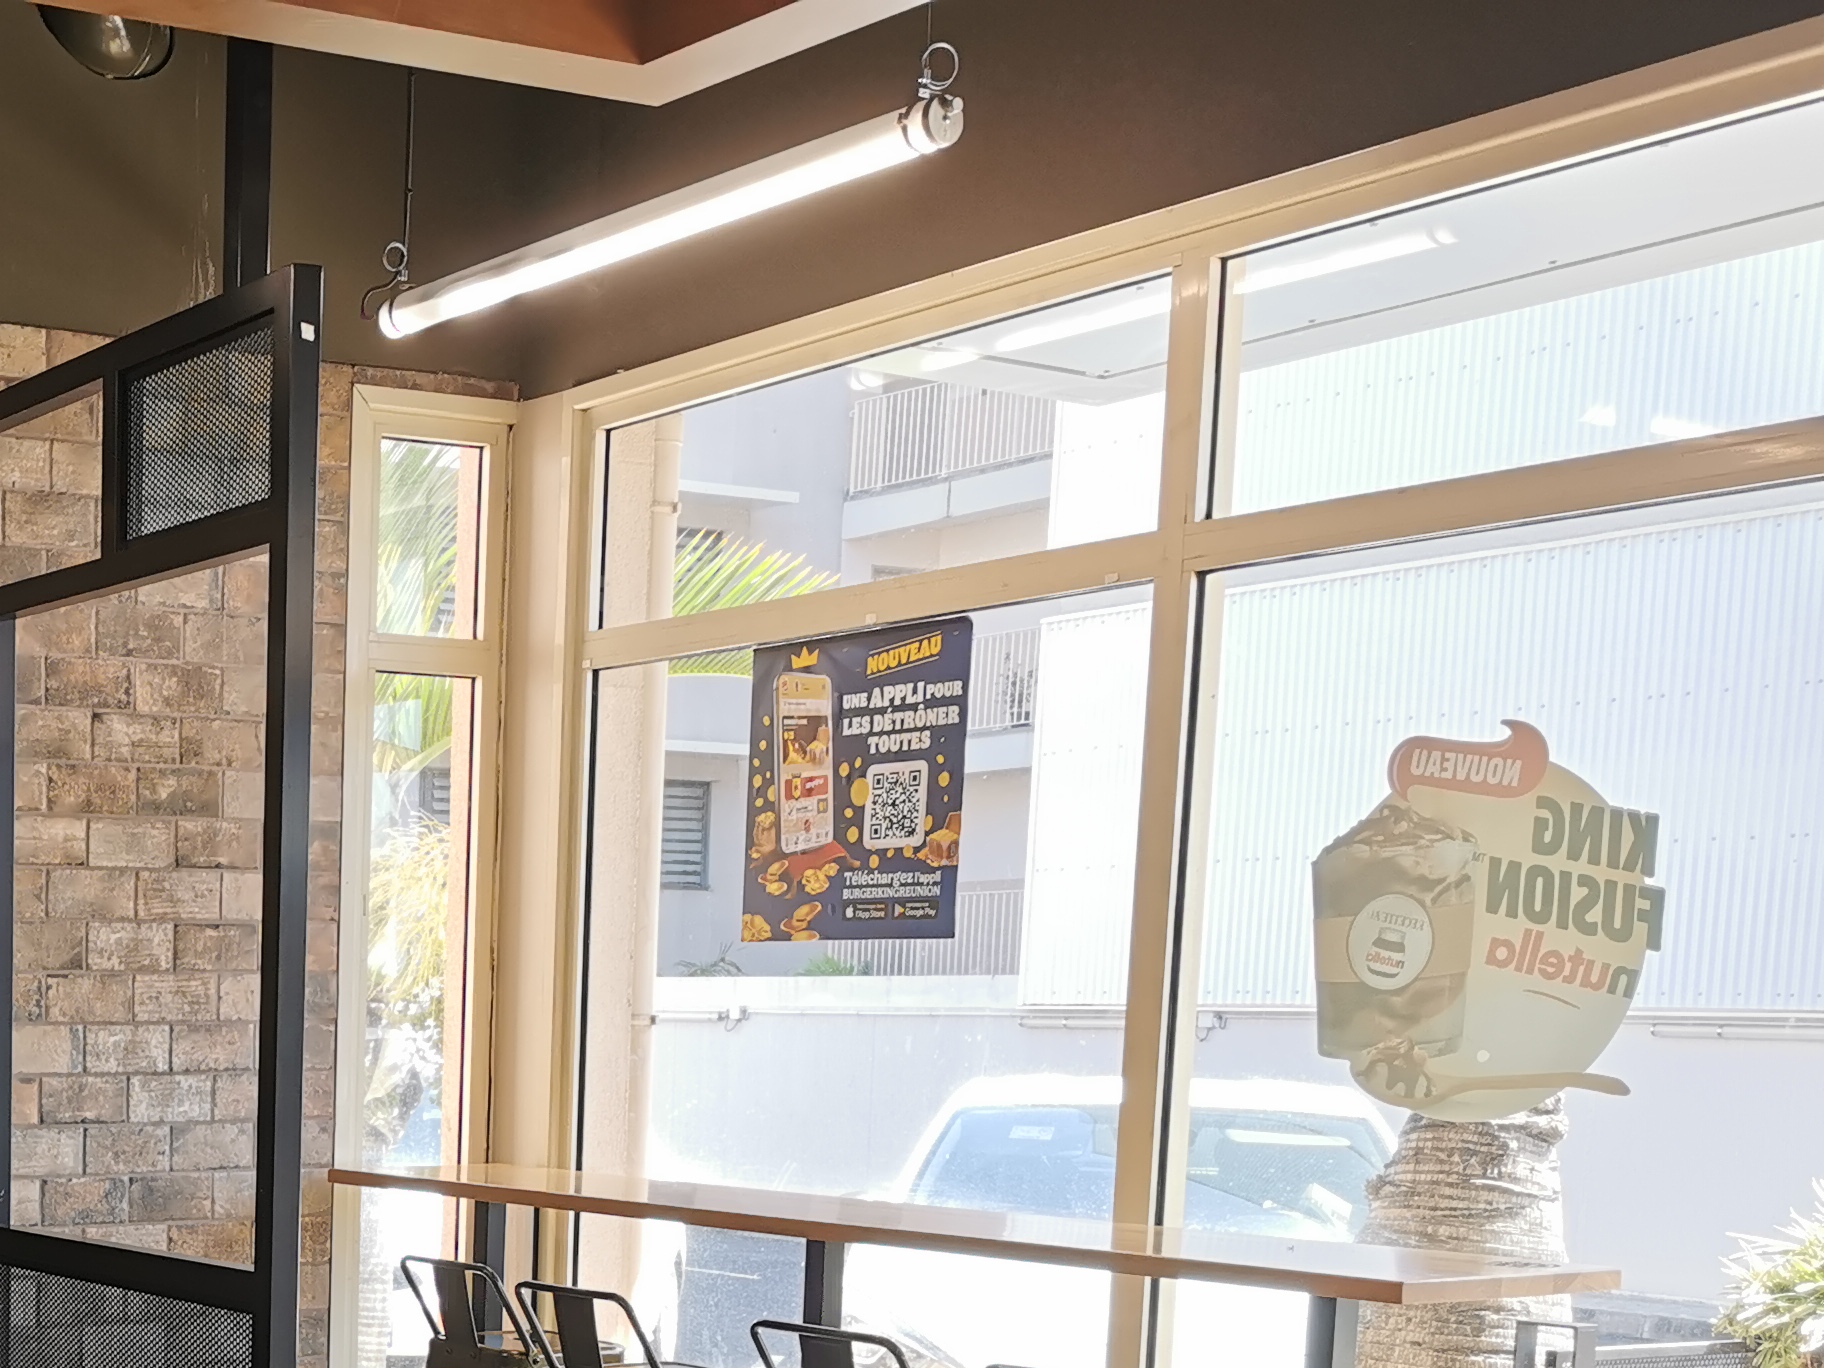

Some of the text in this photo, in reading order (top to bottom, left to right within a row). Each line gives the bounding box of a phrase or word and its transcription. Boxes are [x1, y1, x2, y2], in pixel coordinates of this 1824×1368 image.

[866, 634, 943, 675] NOUVEAU
[842, 680, 963, 710] UNE APPLI POUR
[842, 703, 960, 736] LES DÉTRÔNER
[867, 730, 931, 754] TOUTES
[844, 869, 913, 887] Téléchargez
